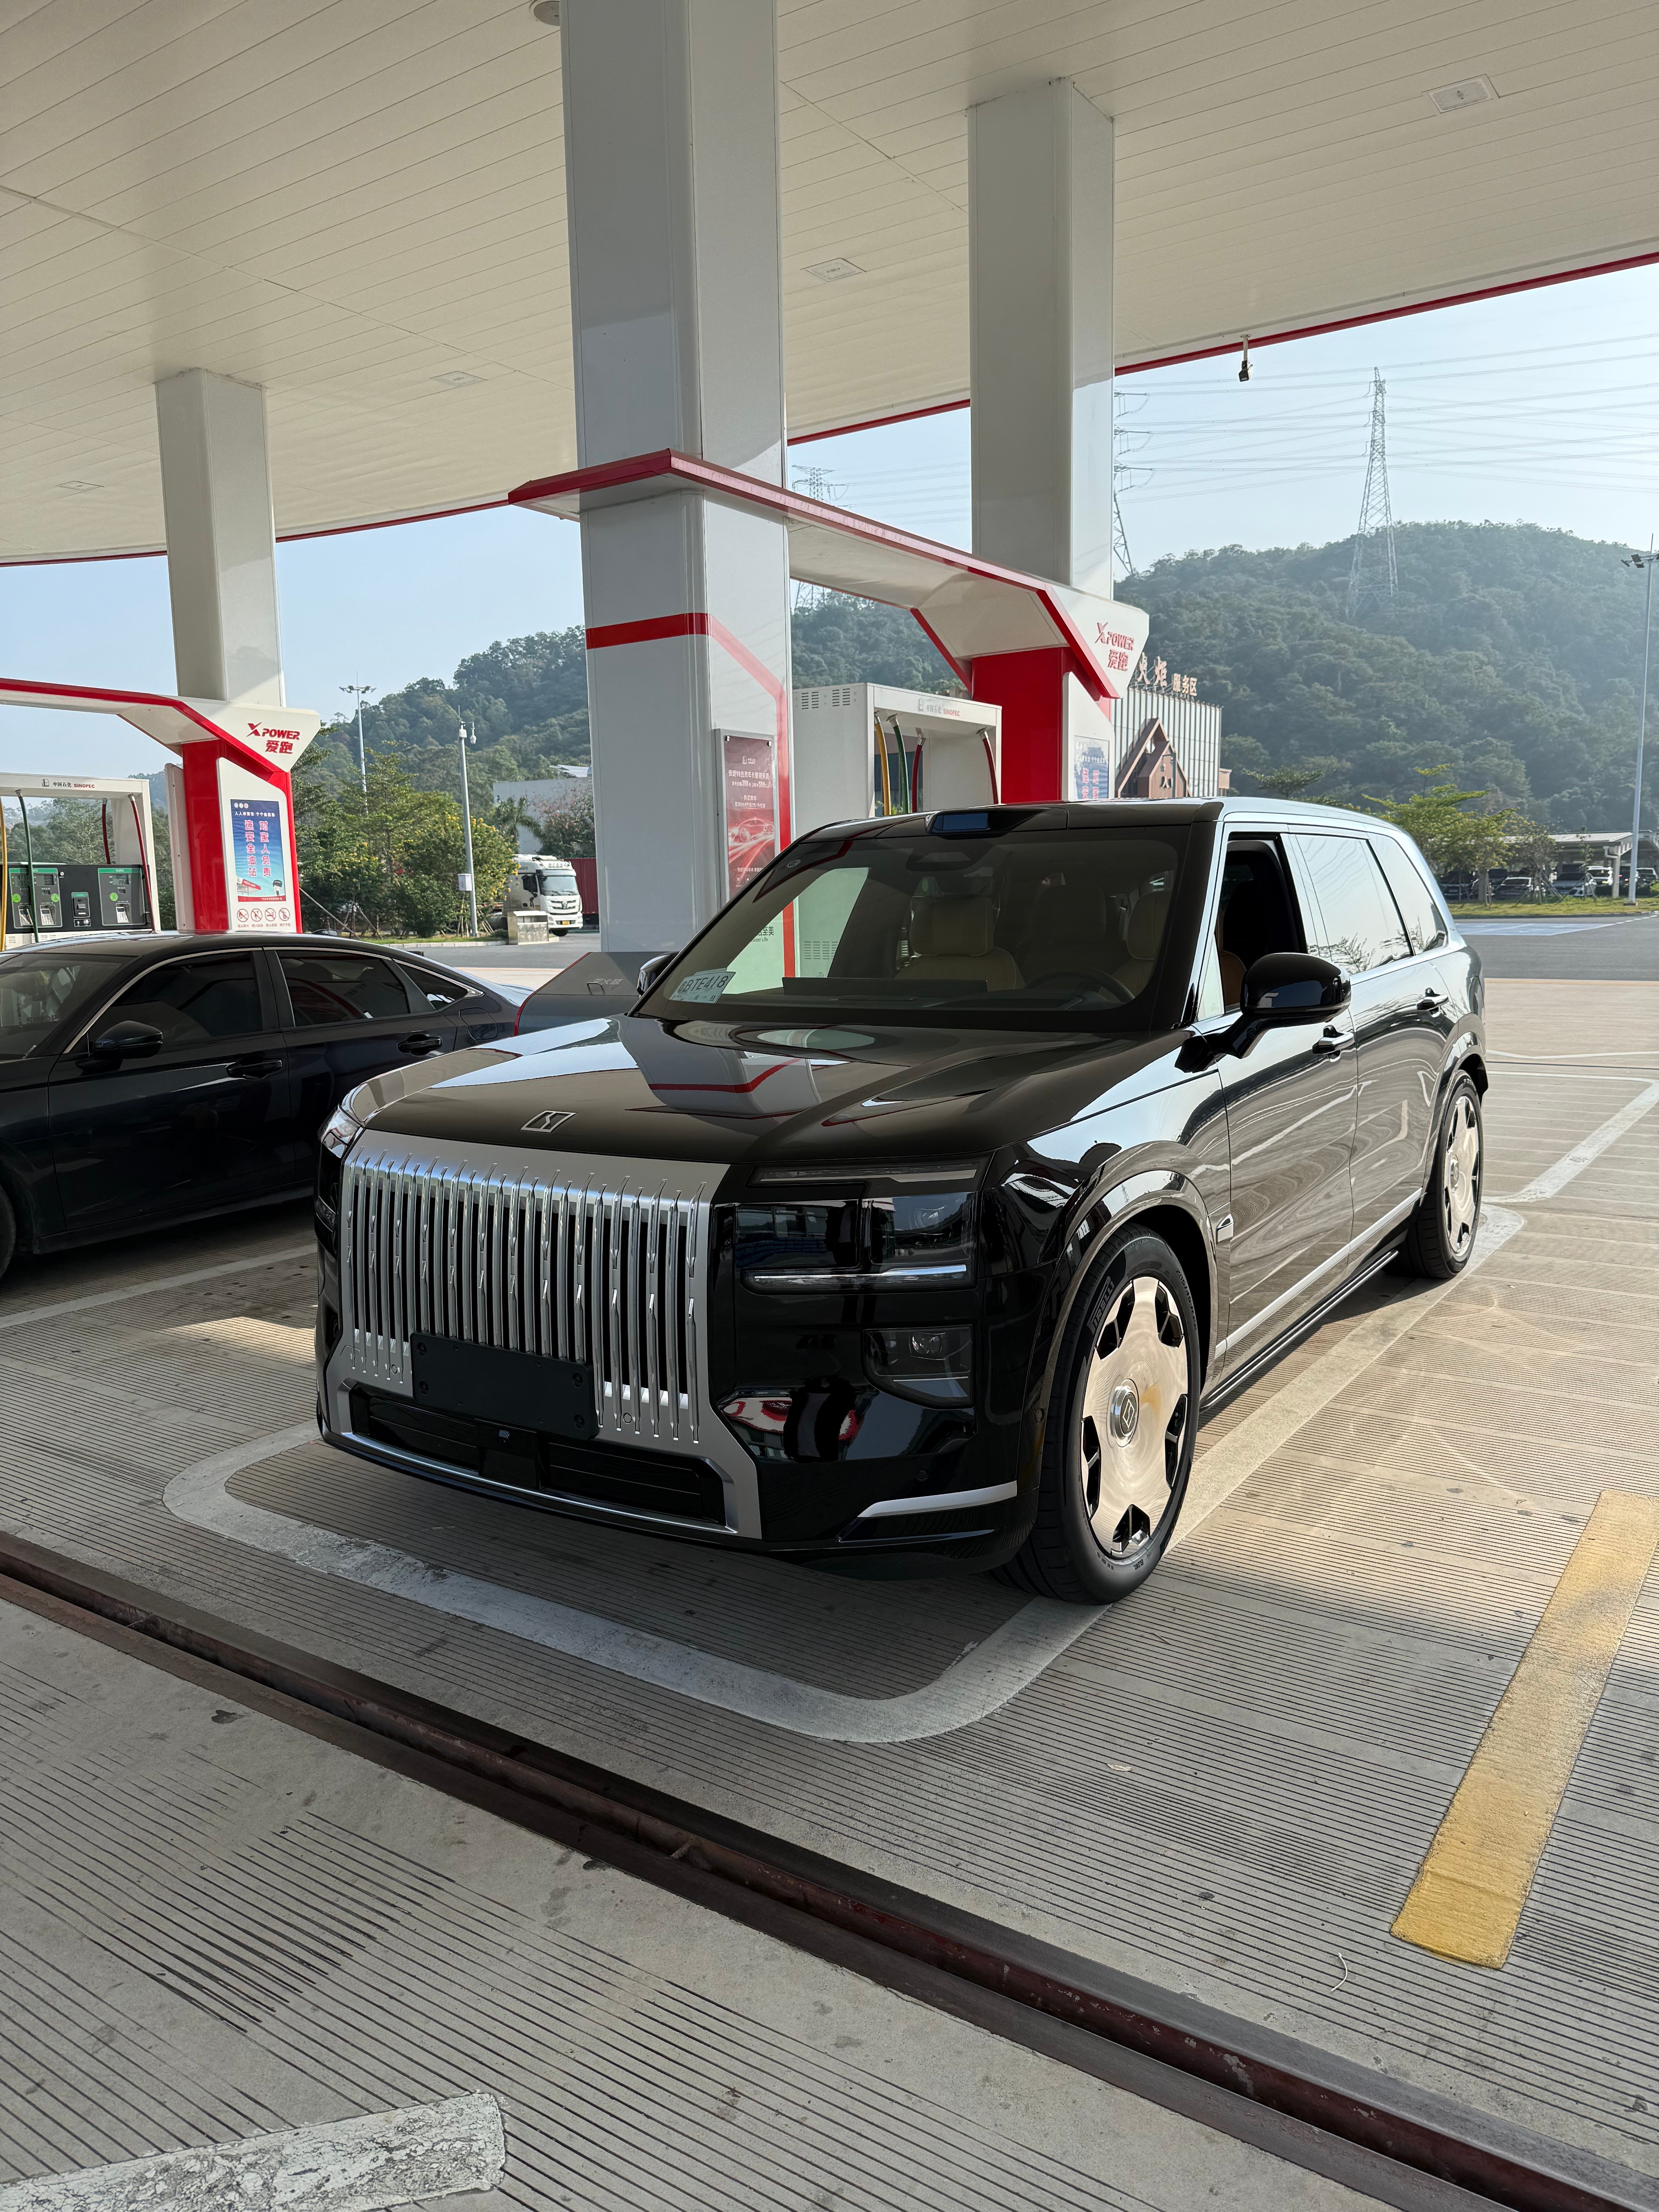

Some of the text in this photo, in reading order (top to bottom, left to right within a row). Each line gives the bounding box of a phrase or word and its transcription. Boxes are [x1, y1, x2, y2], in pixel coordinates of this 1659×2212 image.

[1108, 649, 1128, 672] 爱跑
[1173, 673, 1197, 696] 服务区
[943, 708, 960, 716] SINOPEC
[265, 740, 293, 754] 爱跑
[244, 819, 257, 877] 选安全油站
[1086, 1276, 1115, 1335] PIRELLI
